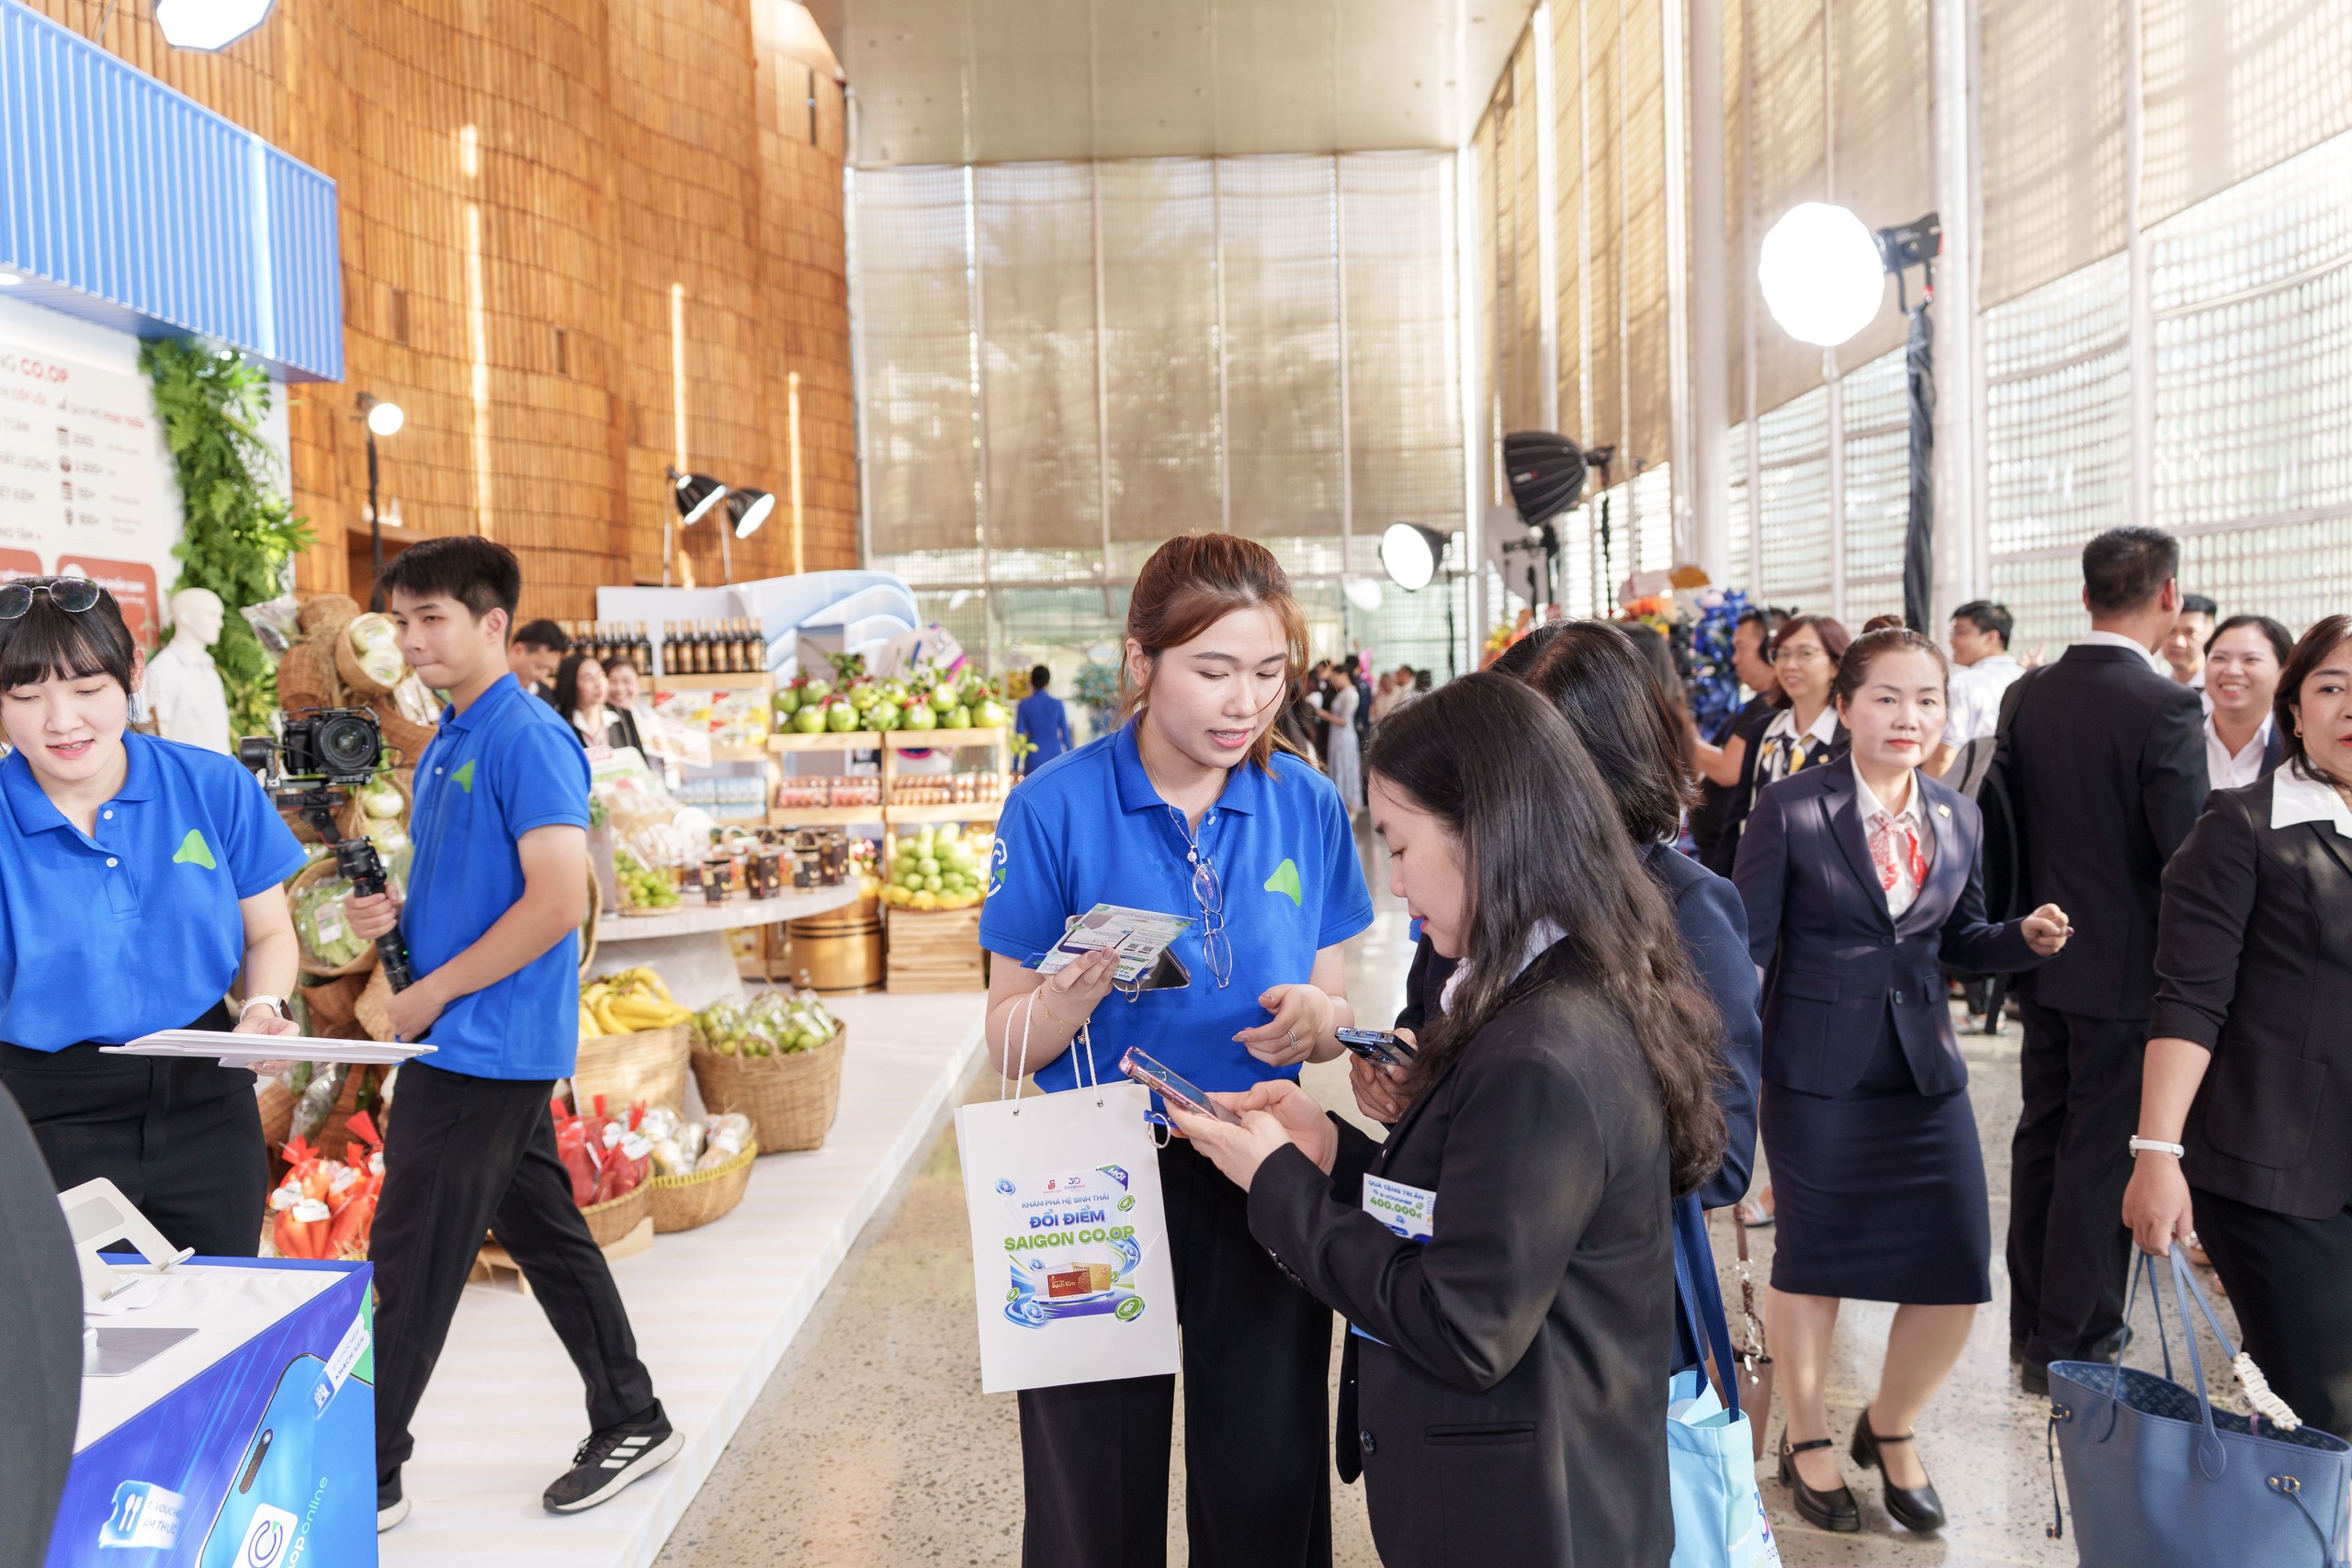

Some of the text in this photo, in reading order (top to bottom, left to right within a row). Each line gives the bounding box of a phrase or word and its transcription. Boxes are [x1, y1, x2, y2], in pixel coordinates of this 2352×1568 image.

[20, 357, 69, 382] CO.OP
[1108, 1168, 1126, 1181] MỚI
[1022, 1193, 1110, 1209] KHÁM PHÁ HỆ SINH THÁI
[1029, 1204, 1105, 1229] ĐỔI ĐIỂM
[1004, 1224, 1136, 1251] SAIGON CO.OP
